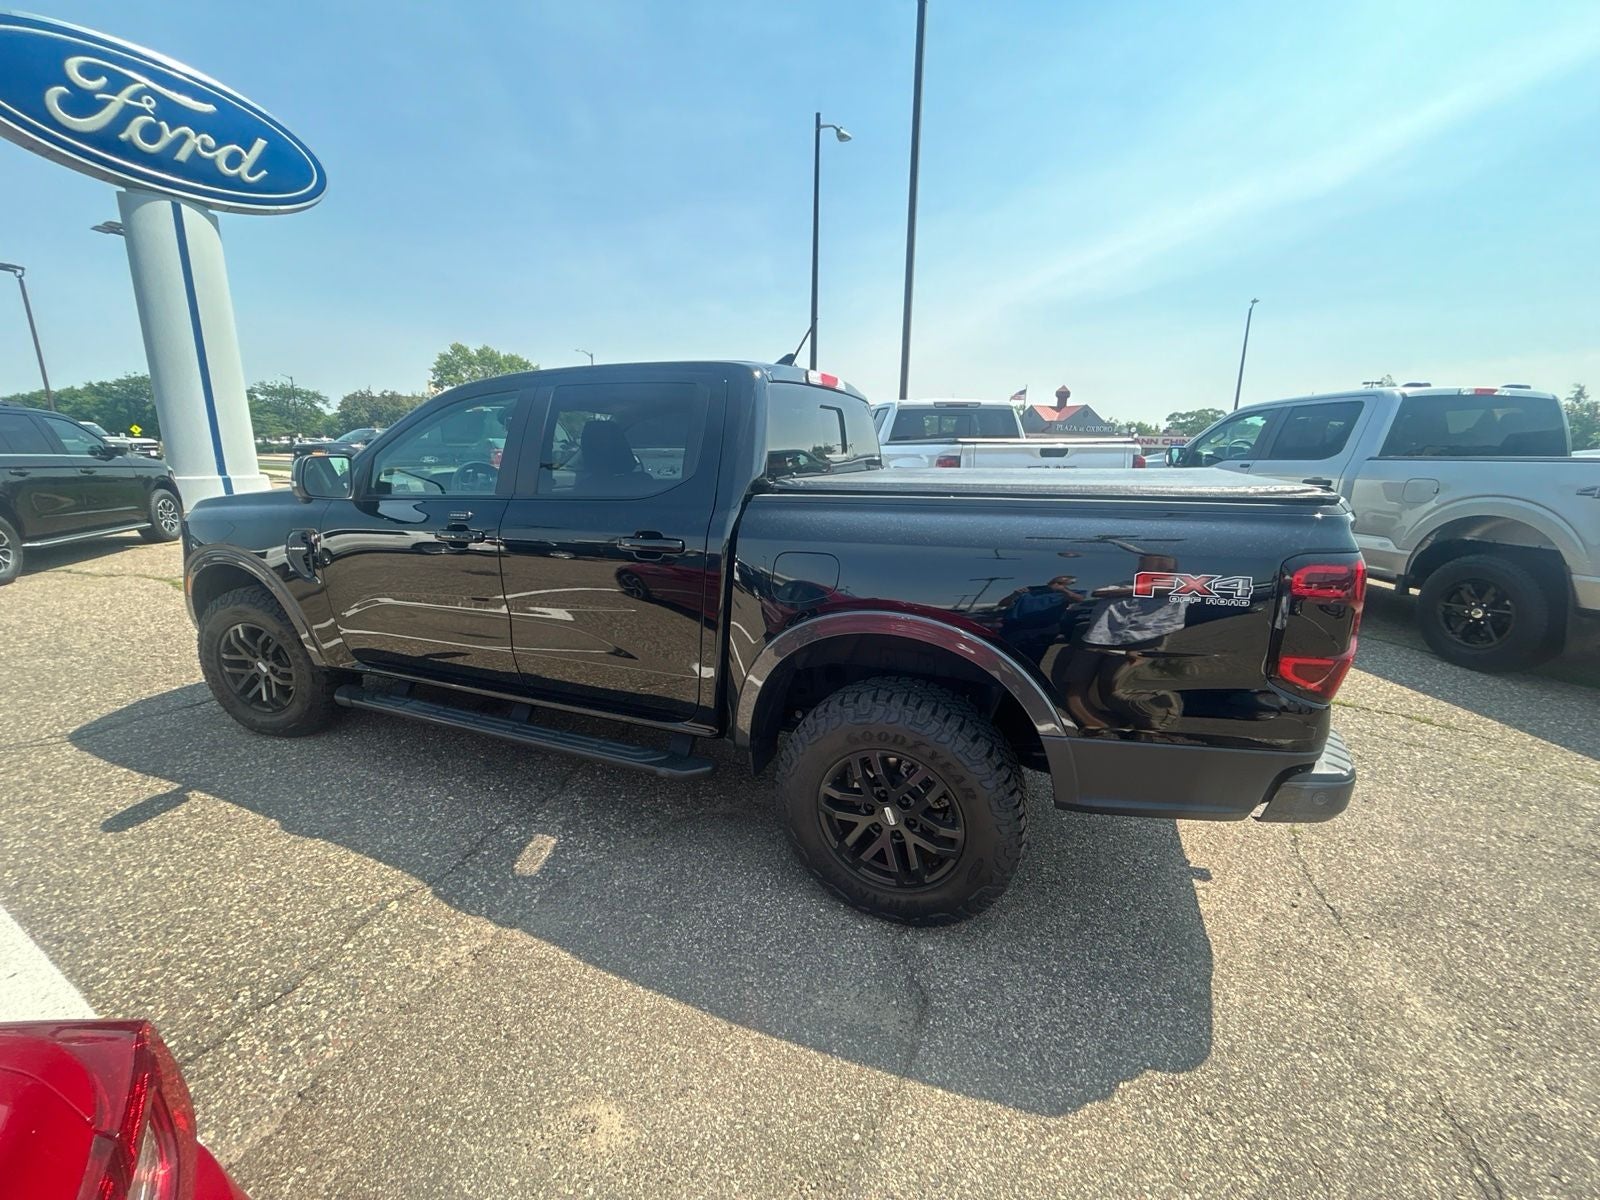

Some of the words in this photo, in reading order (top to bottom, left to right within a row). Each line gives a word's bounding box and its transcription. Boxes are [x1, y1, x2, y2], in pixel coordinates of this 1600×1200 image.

[45, 55, 268, 185] Ford
[1056, 423, 1077, 432] PLAZA
[1086, 424, 1113, 433] OXBORO
[1133, 571, 1254, 599] FX4
[1169, 595, 1201, 604] OFF
[1205, 597, 1250, 607] ROAD
